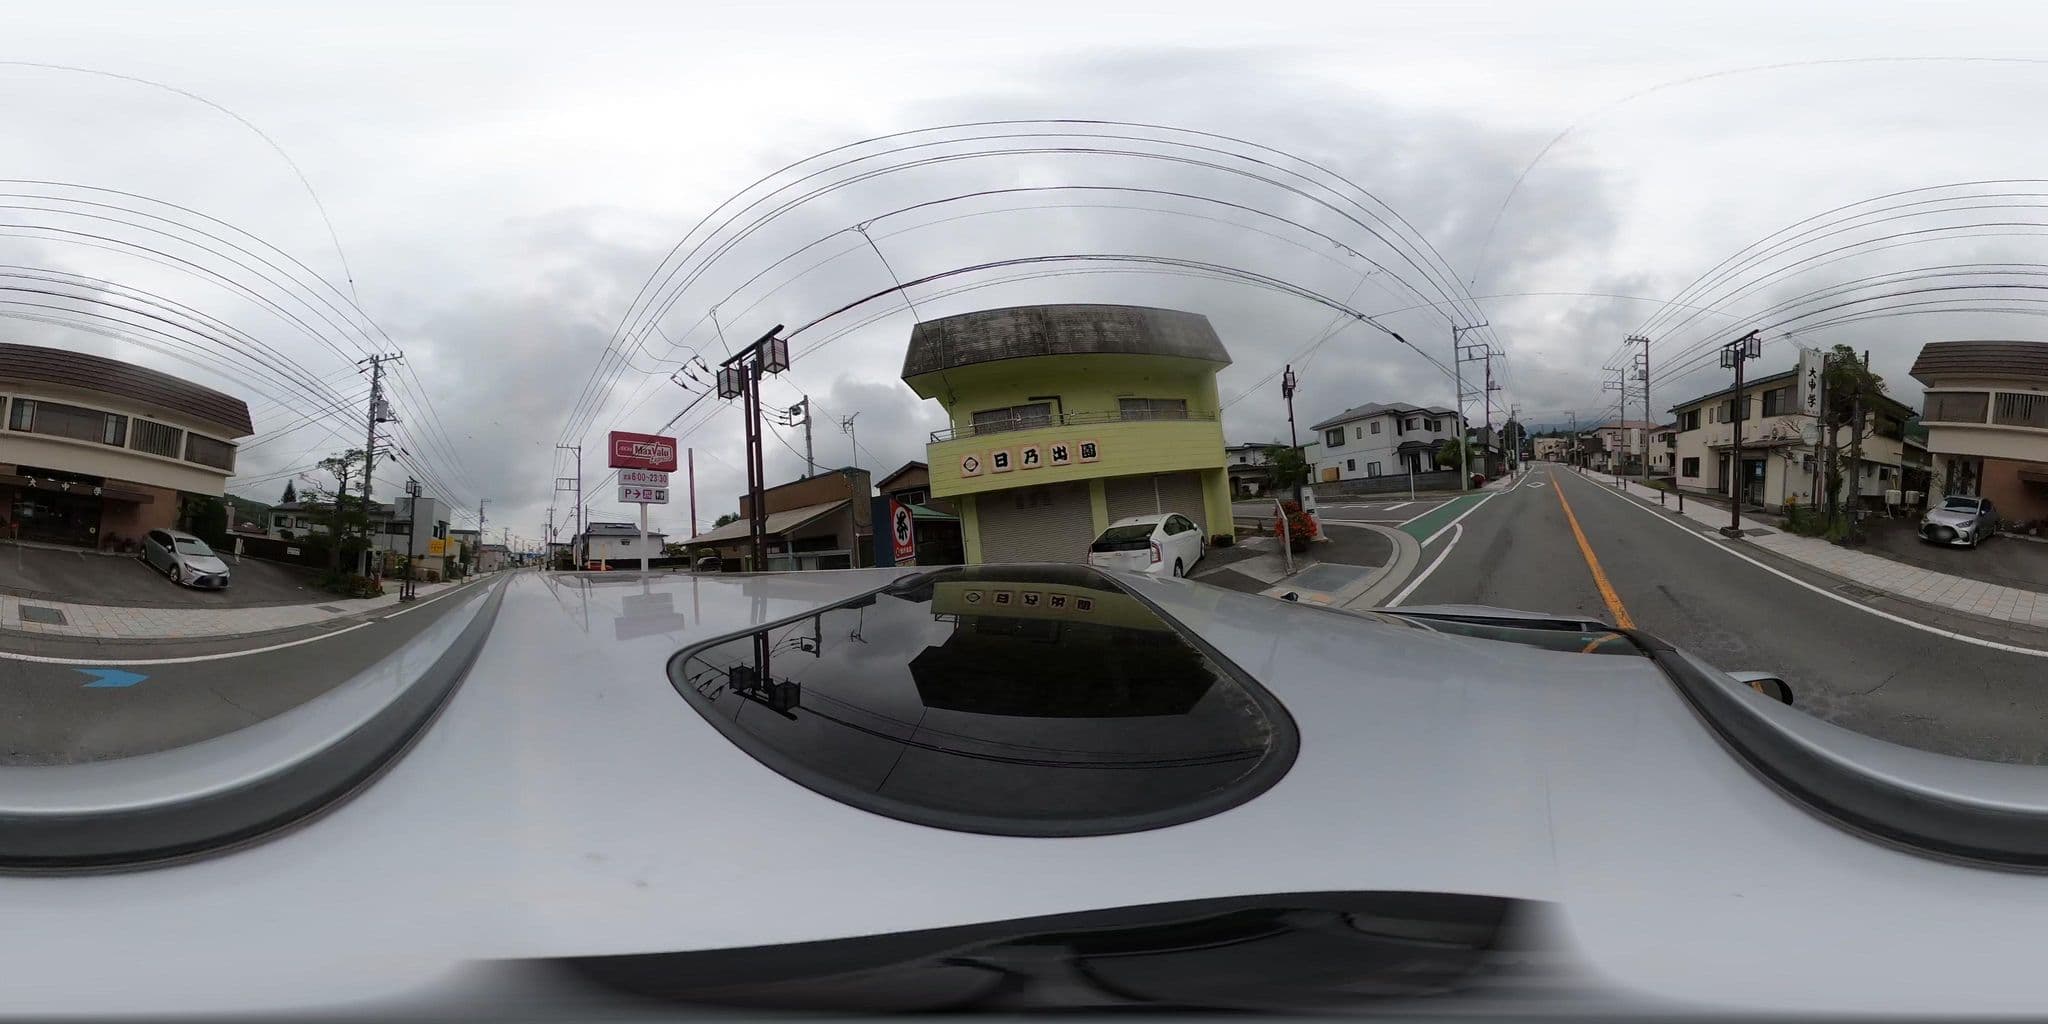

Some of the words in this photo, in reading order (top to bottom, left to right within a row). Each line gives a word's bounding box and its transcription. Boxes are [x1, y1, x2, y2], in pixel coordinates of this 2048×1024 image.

[634, 443, 669, 458] MaxValu
[994, 442, 1096, 468] 日乃出園
[624, 488, 632, 499] P
[896, 510, 908, 541] 茶
